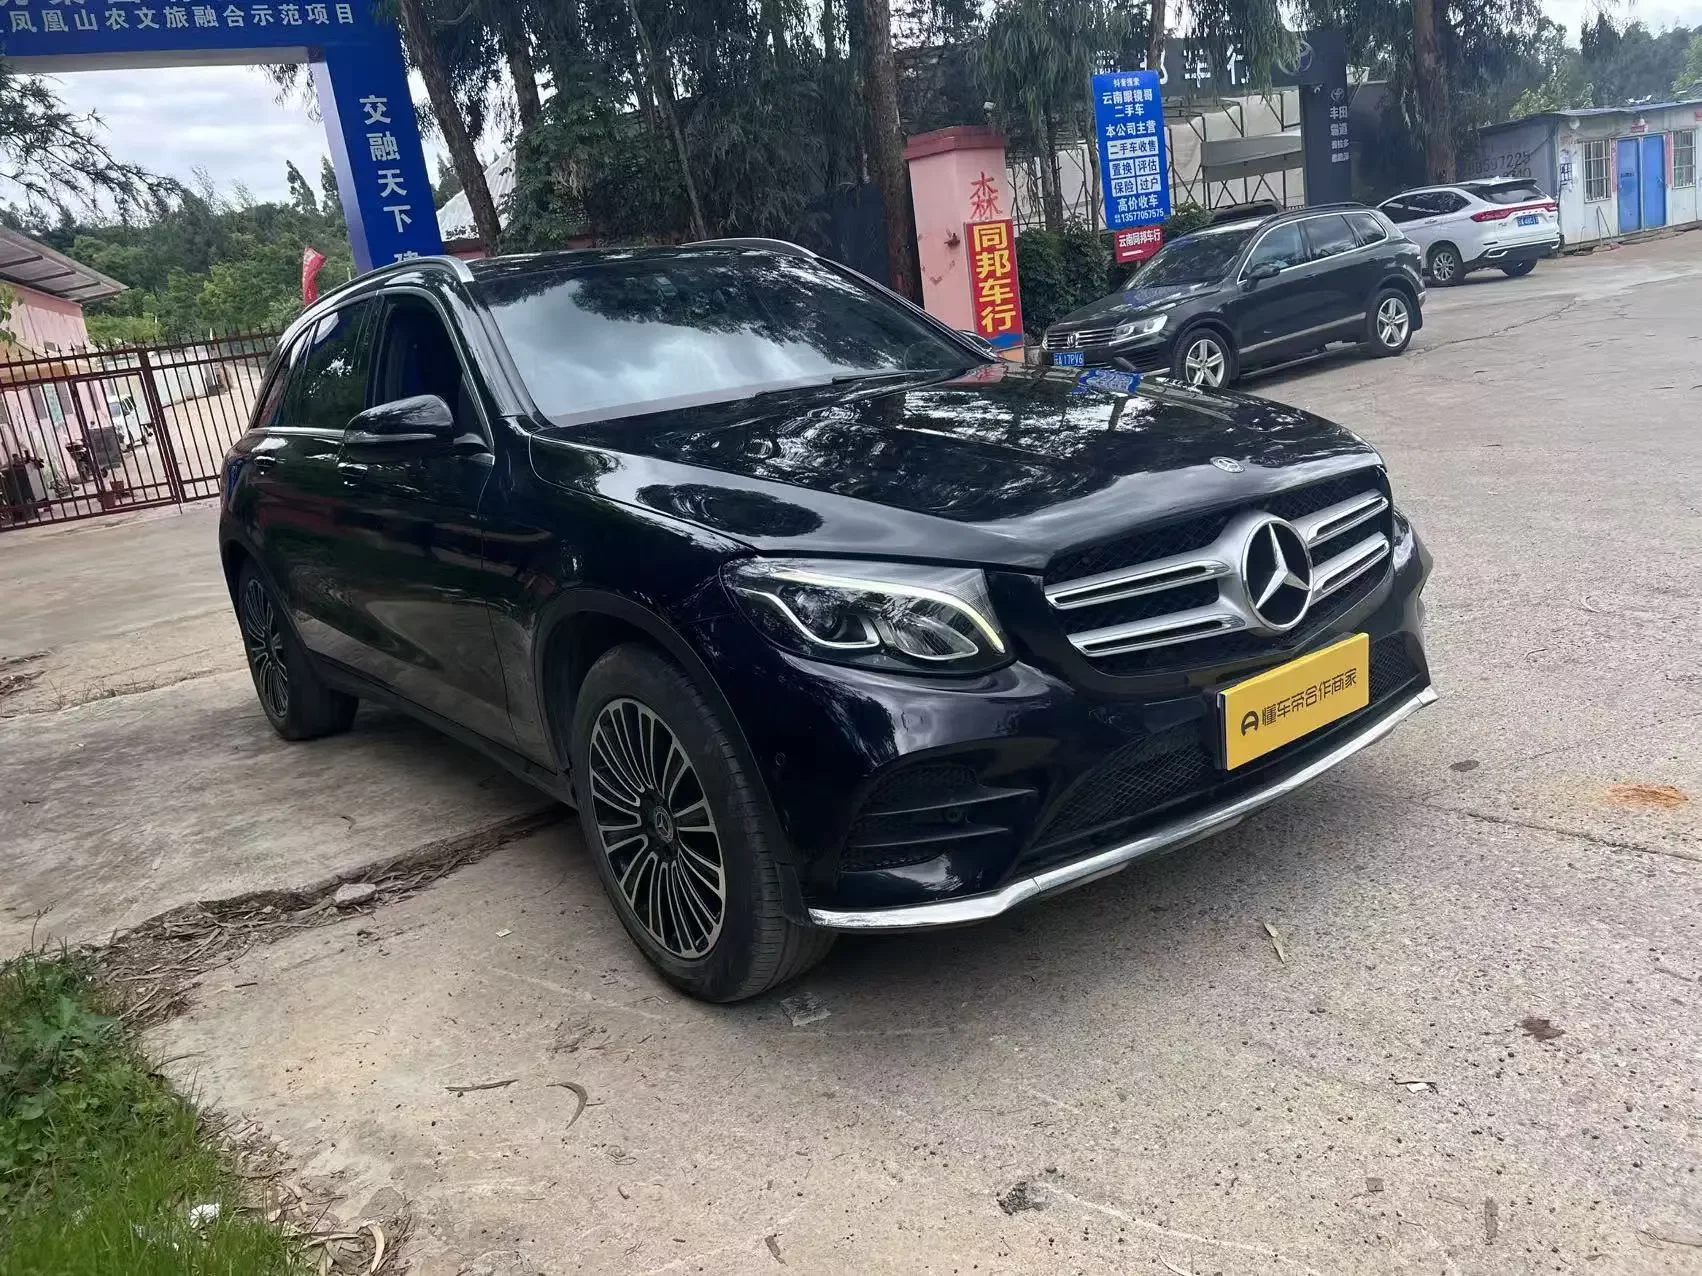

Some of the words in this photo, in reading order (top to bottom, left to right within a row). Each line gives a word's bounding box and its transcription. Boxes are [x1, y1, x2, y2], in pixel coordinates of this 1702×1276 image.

[0, 3, 354, 33] 凤凰山农文旅融合示范项目
[1102, 88, 1153, 105] 云南眼镜哥
[1114, 103, 1145, 117] 二手车
[1330, 106, 1348, 119] 丰田
[1105, 119, 1157, 138] 本公司主营
[1109, 139, 1157, 155] 二手车收售
[359, 94, 412, 233] 交融天下
[1112, 162, 1133, 177] 置换
[1137, 159, 1157, 174] 评估
[1114, 180, 1135, 195] 保险
[1139, 177, 1159, 192] 过户
[1117, 194, 1159, 212] 高价收车
[1121, 208, 1164, 223] 13577057575
[1118, 229, 1161, 248] 云南同邦车行
[973, 222, 1017, 333] 同邦车行
[1262, 667, 1357, 727] 懂车帝合作商家
